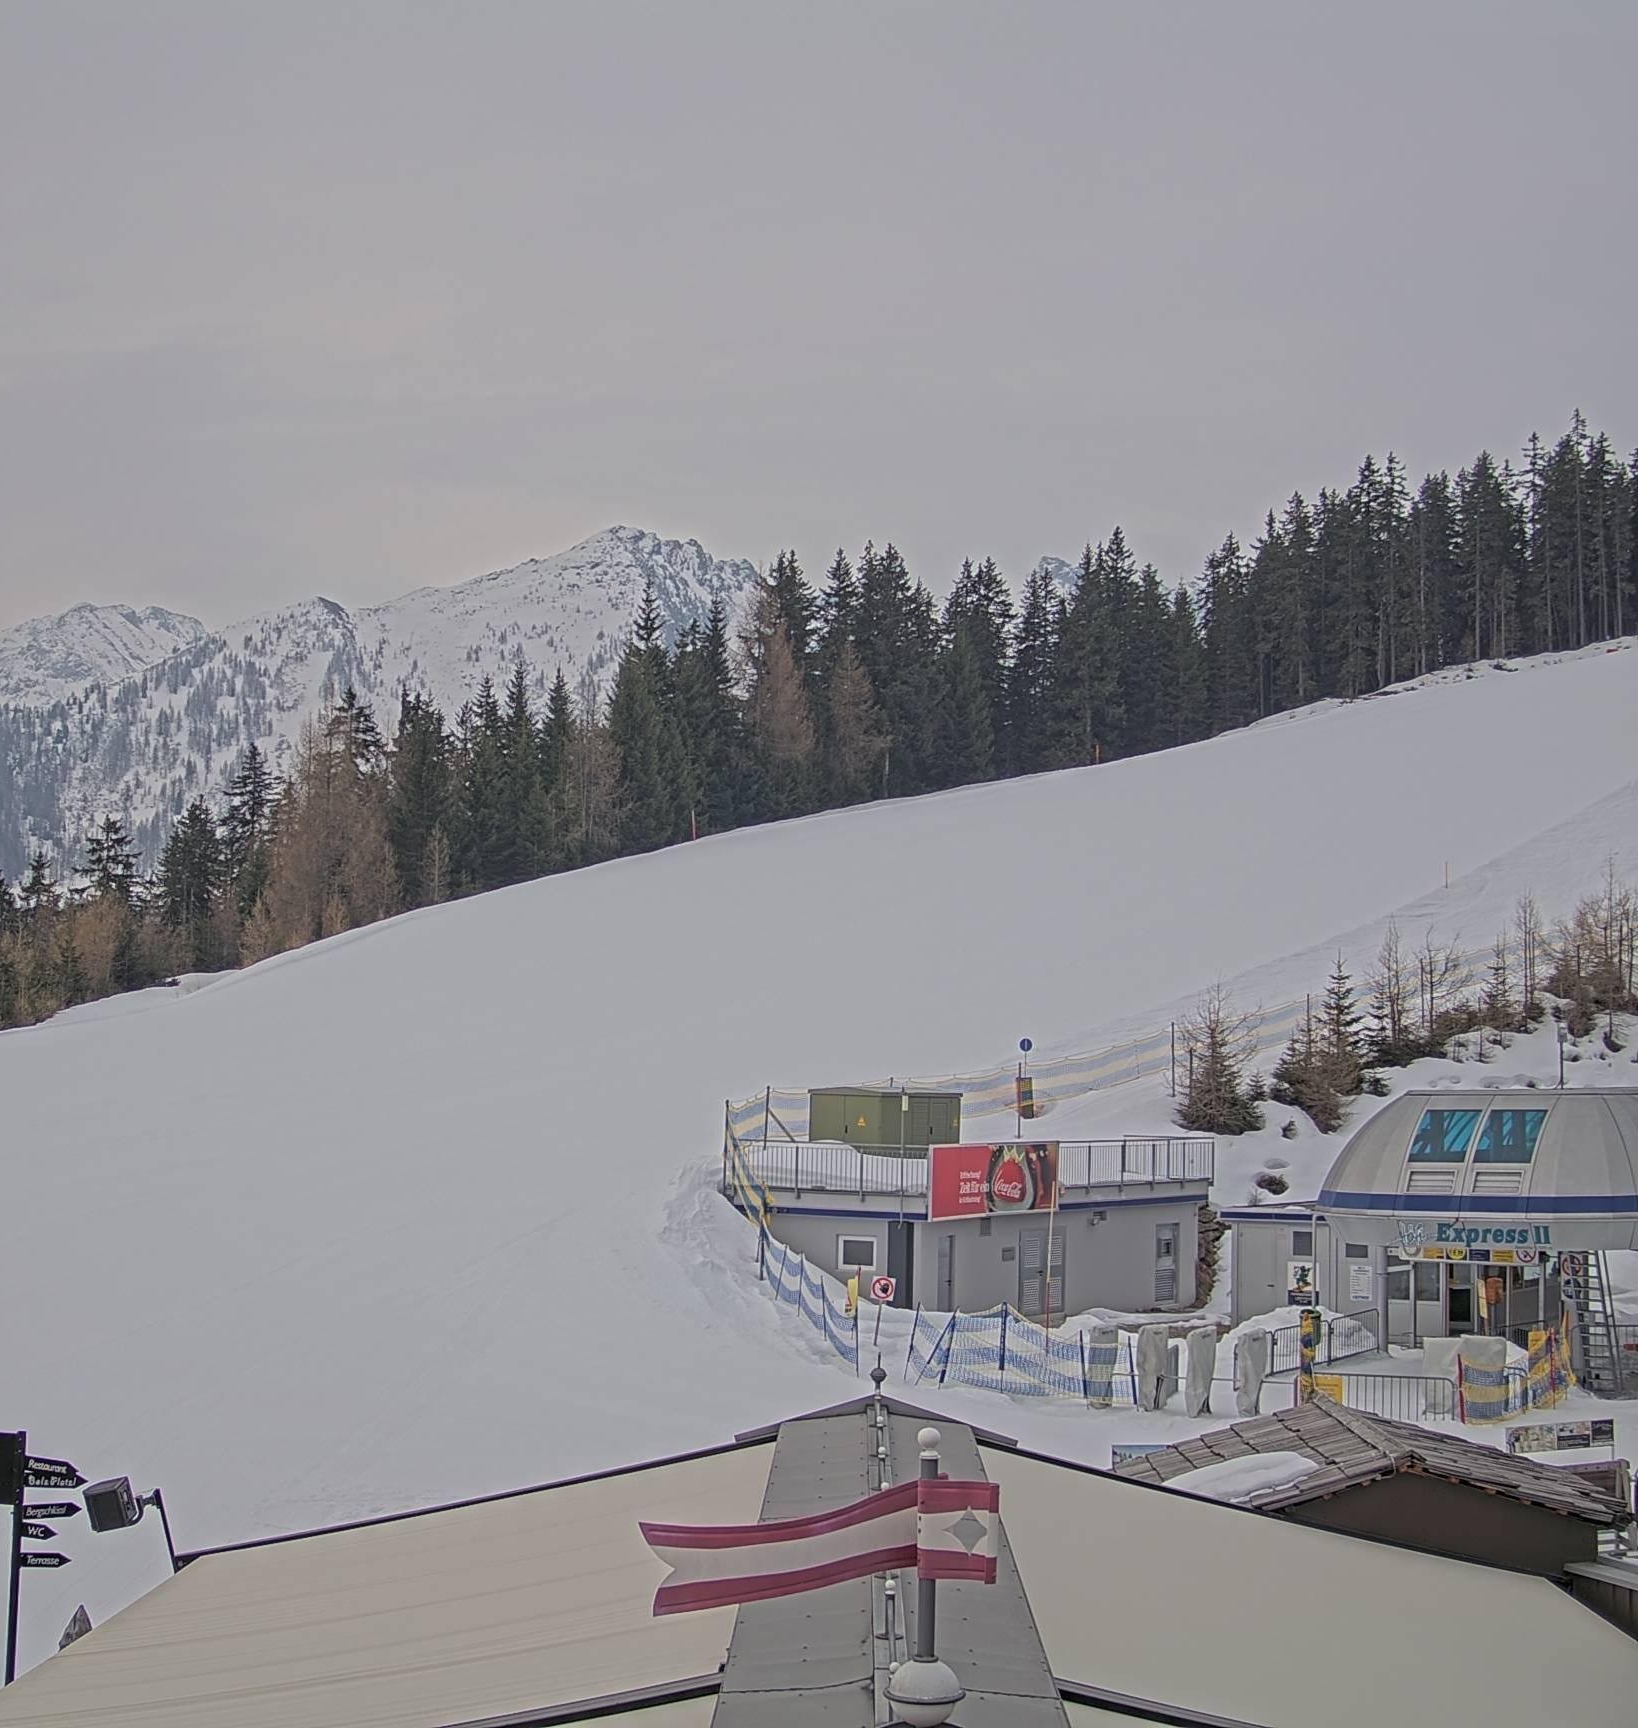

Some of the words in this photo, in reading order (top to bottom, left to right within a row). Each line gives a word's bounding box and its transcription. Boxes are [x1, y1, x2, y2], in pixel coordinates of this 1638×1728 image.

[1435, 1222, 1529, 1247] Express
[28, 1459, 67, 1474] Restaurant
[27, 1525, 45, 1537] WC
[26, 1555, 60, 1566] Terrasse
